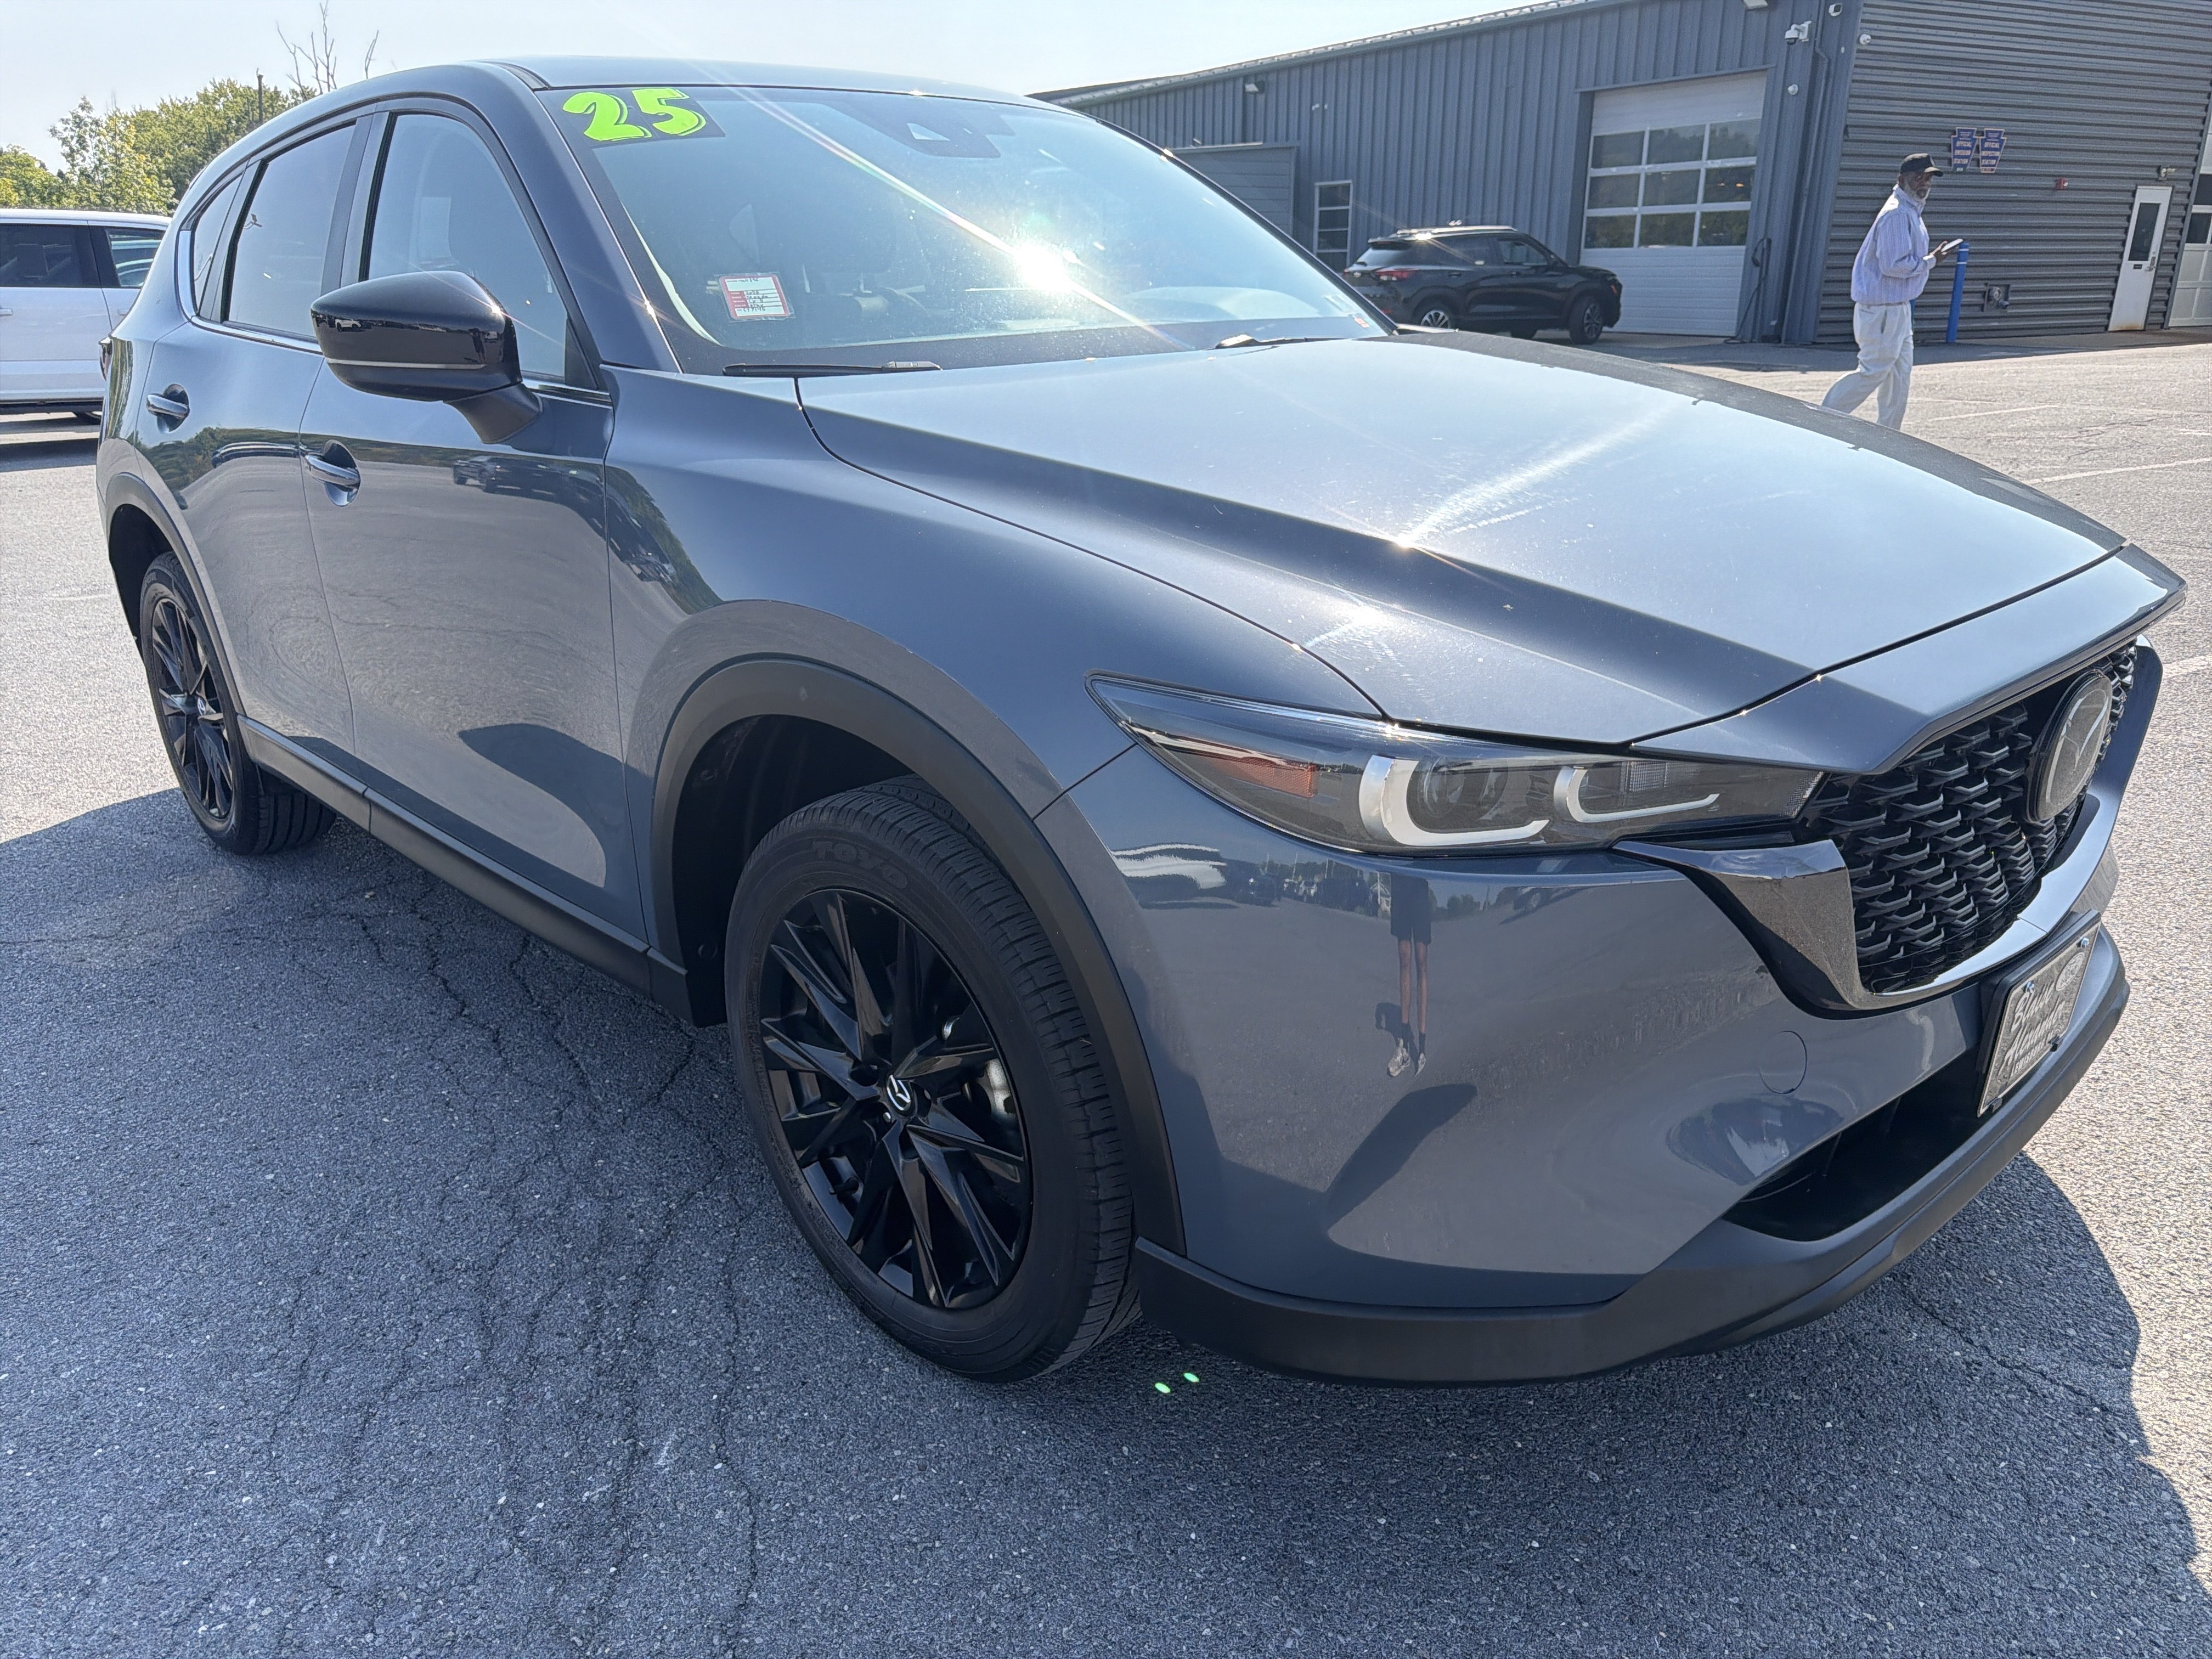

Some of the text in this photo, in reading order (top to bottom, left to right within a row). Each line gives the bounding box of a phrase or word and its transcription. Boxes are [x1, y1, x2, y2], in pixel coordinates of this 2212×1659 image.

[562, 88, 707, 141] 25
[812, 841, 909, 889] TOYO
[2011, 981, 2055, 1032] Blaise
[1998, 996, 2066, 1075] Alexander
